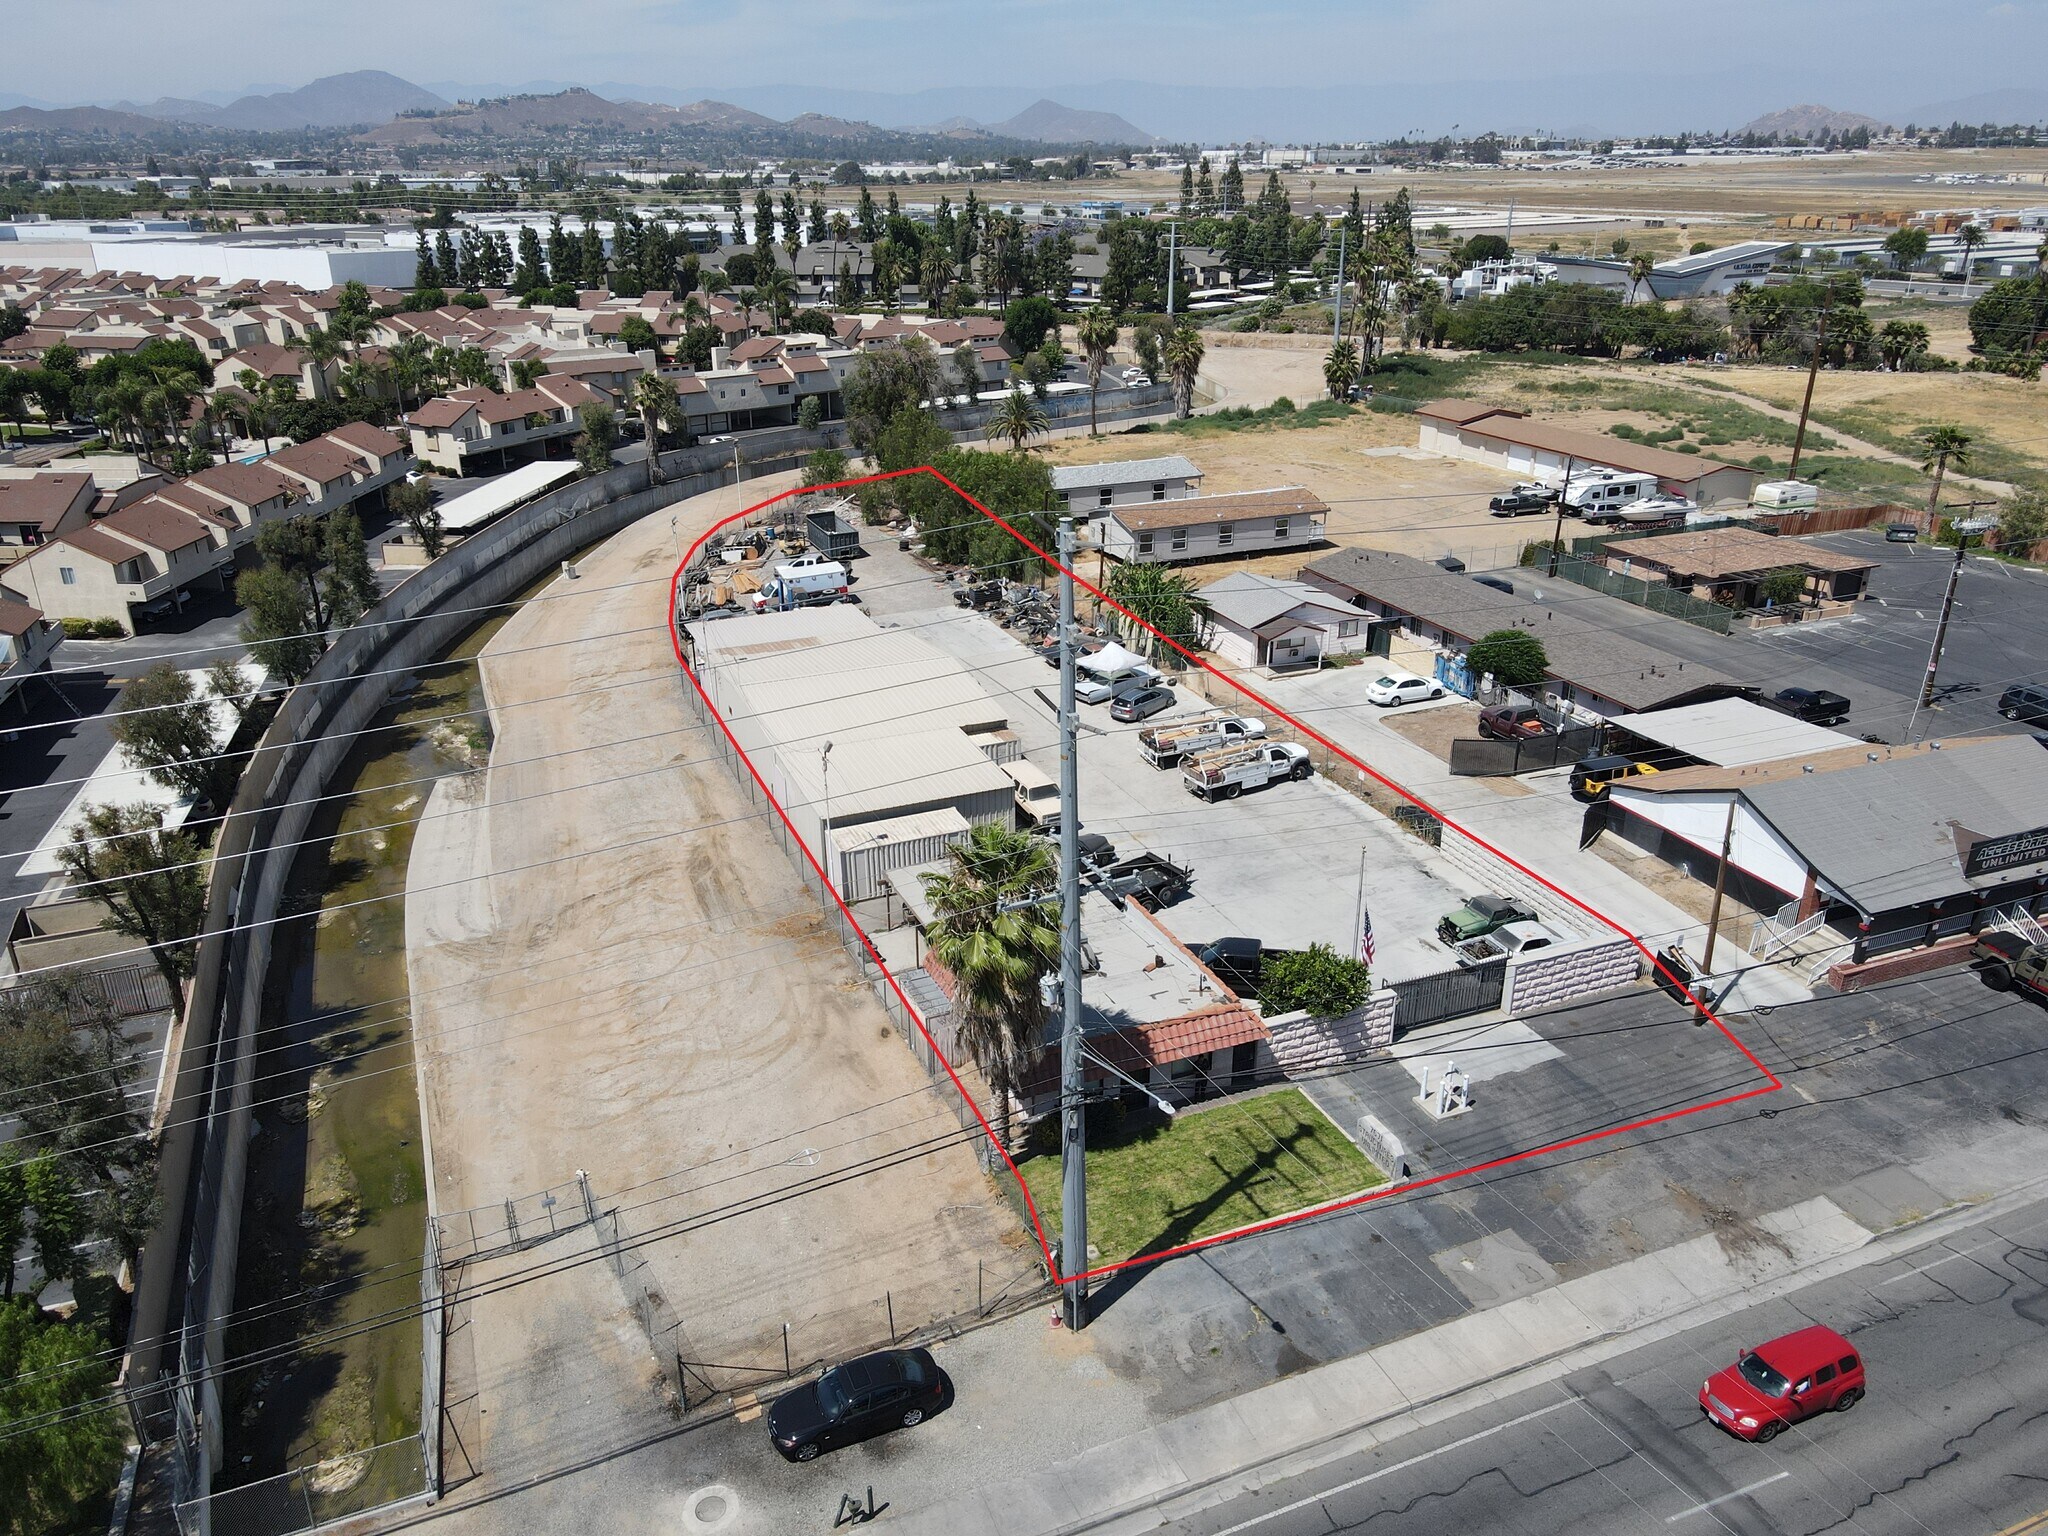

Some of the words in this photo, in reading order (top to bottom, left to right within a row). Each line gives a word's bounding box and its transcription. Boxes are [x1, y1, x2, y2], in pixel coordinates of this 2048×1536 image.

[1981, 848, 2046, 868] UNLIMITED
[1358, 1123, 1395, 1163] STRUCTURES
[1361, 1136, 1390, 1168] UNLIMITED
